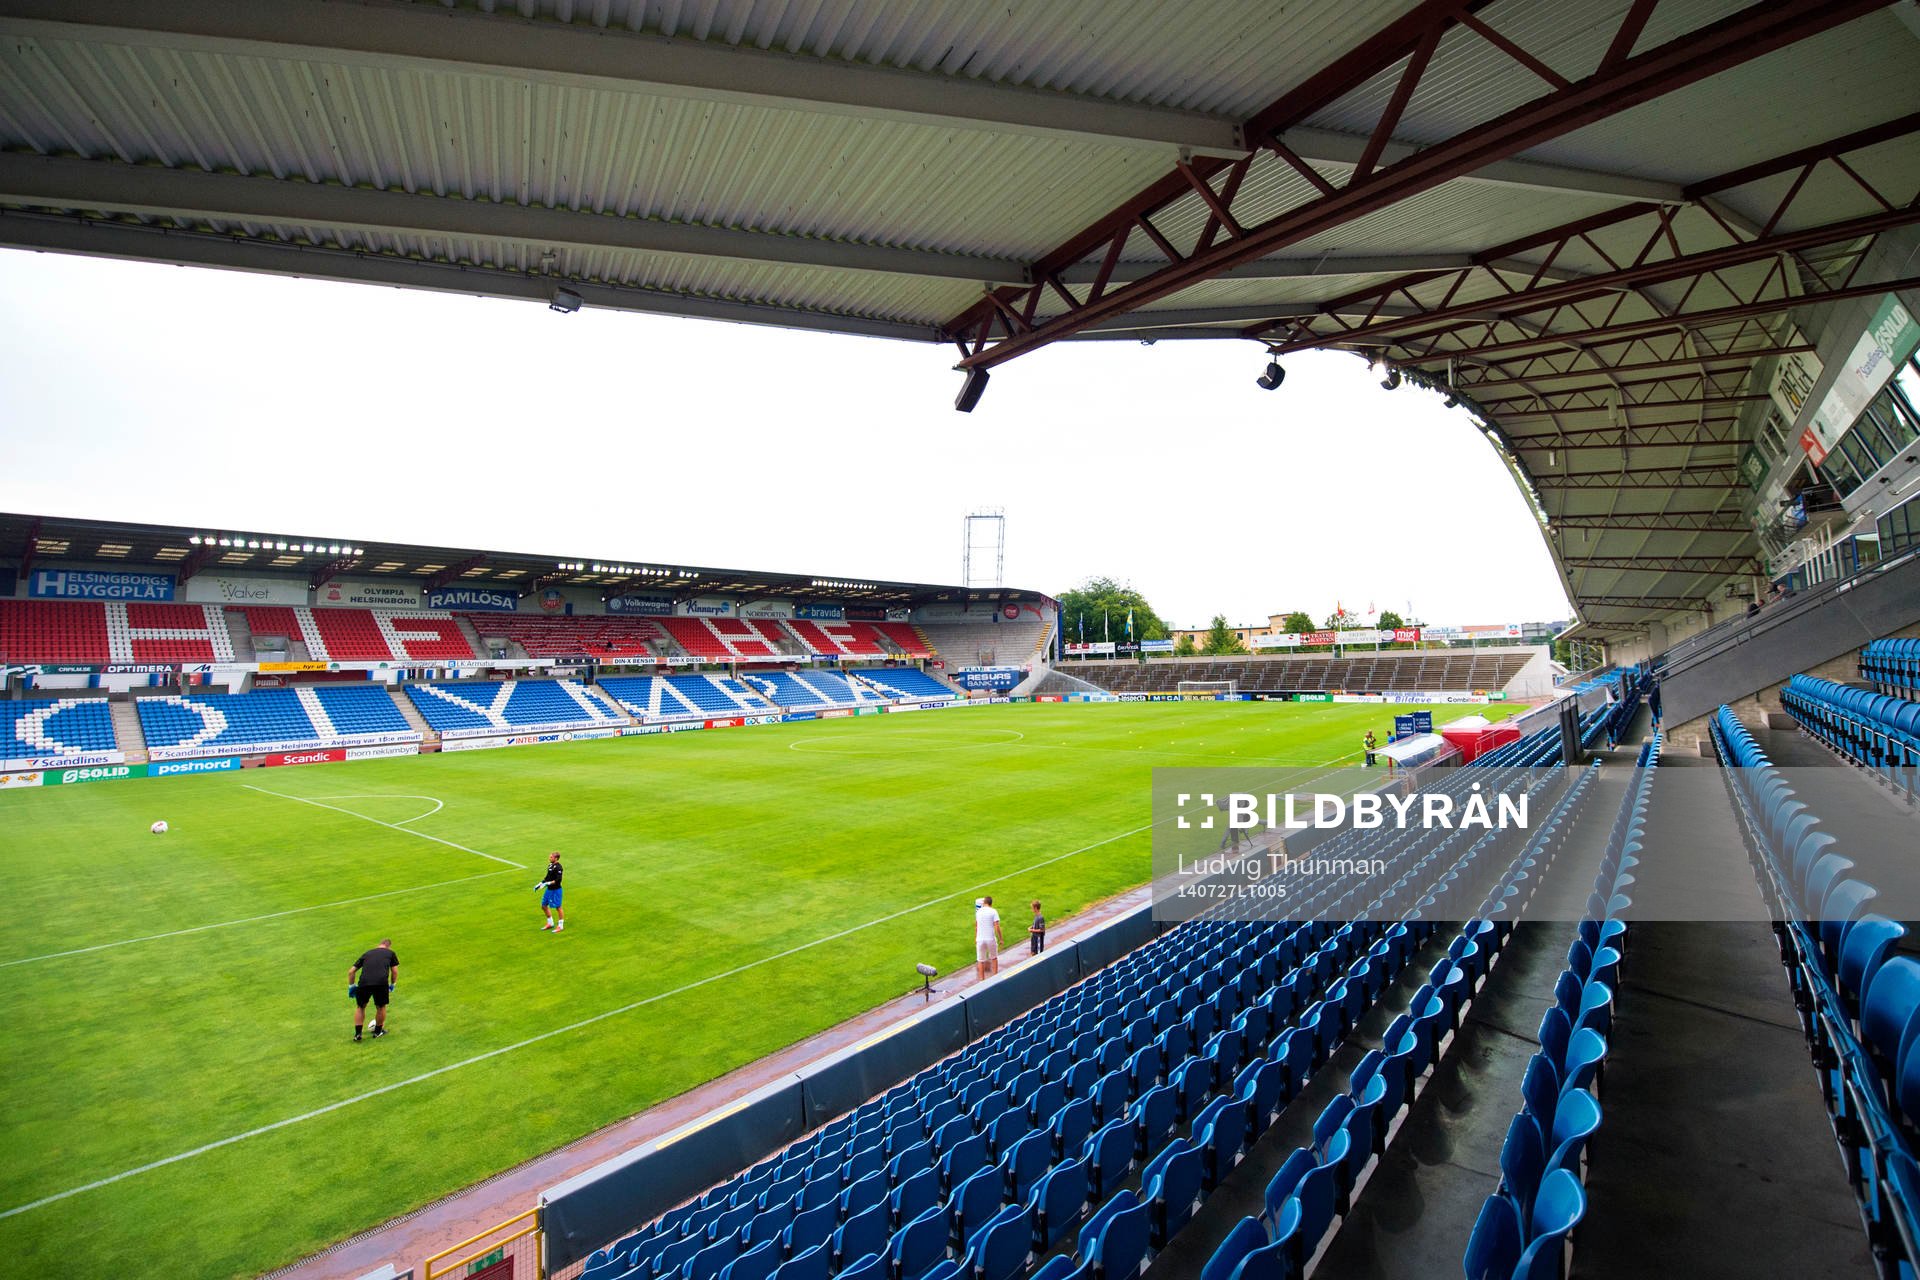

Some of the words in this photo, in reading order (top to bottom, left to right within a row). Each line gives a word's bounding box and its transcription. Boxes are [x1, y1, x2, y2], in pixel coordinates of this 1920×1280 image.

[37, 572, 168, 595] HELSINGBORGS
[67, 583, 168, 598] BYGGPLÅT
[226, 584, 271, 599] Valvet
[350, 596, 417, 604] HELSINGBORG
[430, 590, 514, 609] RAMLÖSA
[624, 599, 670, 609] Volkswagen
[811, 607, 841, 617] bravida
[1396, 629, 1416, 639] mix
[108, 665, 172, 673] OPTIMERA
[967, 673, 1011, 681] RESURS
[516, 734, 560, 744] INTERSPORT
[165, 748, 216, 757] Scandlines
[217, 745, 273, 754] Helsingborg
[42, 755, 109, 767] Scandlines
[283, 753, 330, 765] Scandic
[78, 766, 130, 779] SOLID
[158, 759, 231, 775] postnord
